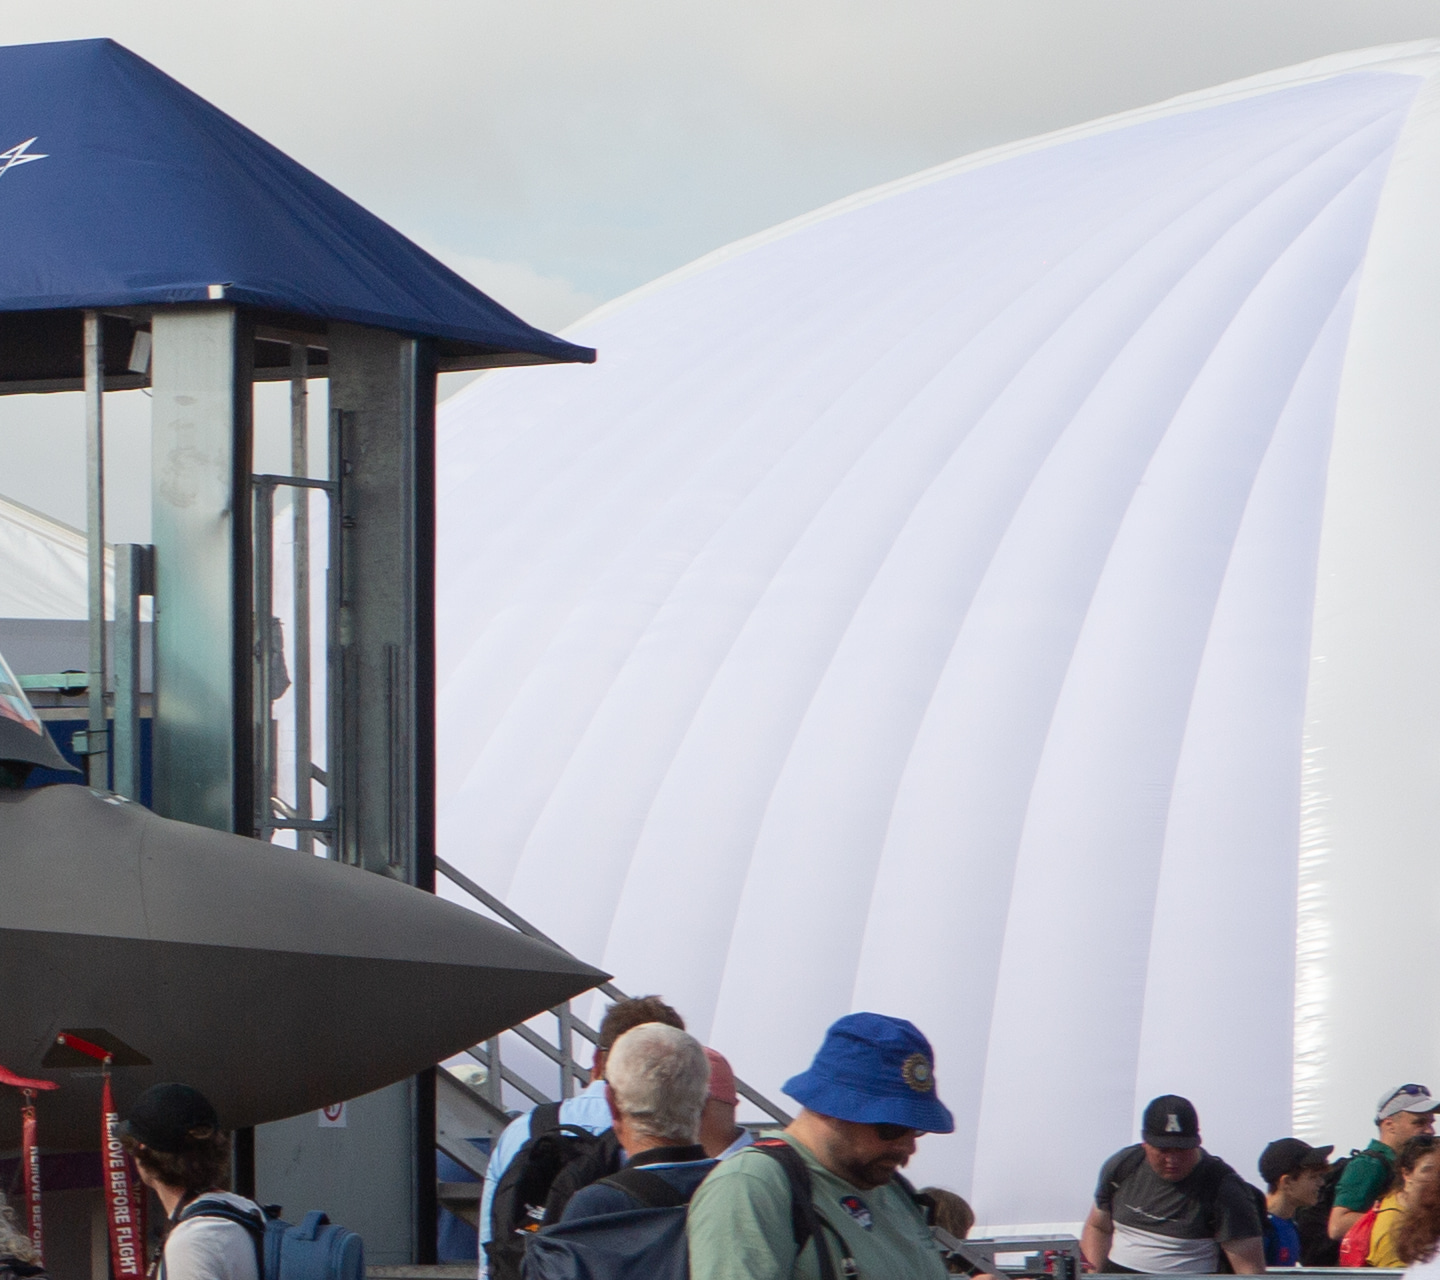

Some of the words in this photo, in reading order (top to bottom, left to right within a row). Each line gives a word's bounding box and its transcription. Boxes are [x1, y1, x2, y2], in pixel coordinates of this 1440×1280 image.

[1165, 1114, 1183, 1132] A
[109, 1171, 130, 1224] BEFORE
[116, 1227, 138, 1275] FLIGHT
